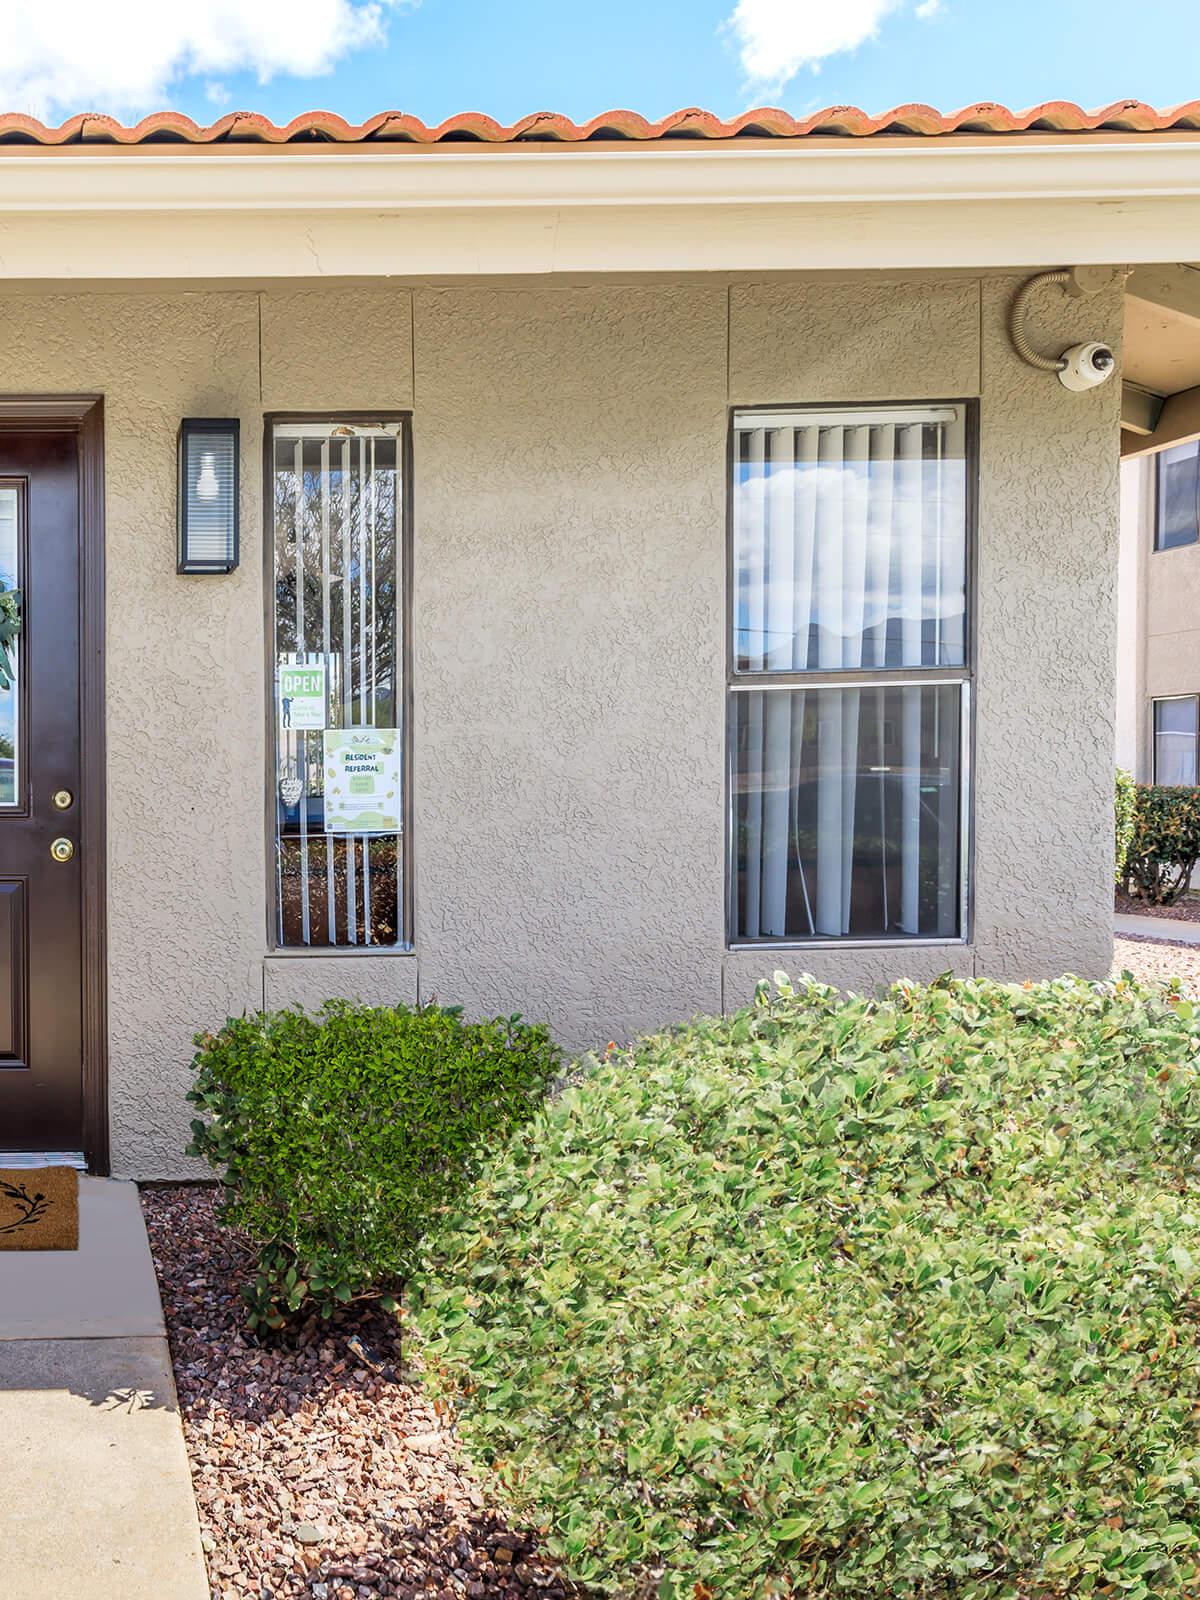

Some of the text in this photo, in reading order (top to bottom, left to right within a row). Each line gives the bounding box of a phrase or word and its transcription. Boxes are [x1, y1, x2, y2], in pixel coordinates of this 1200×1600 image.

[284, 675, 320, 692] OPEN
[345, 753, 376, 761] RESIDENT
[345, 764, 380, 772] REFERRAL
